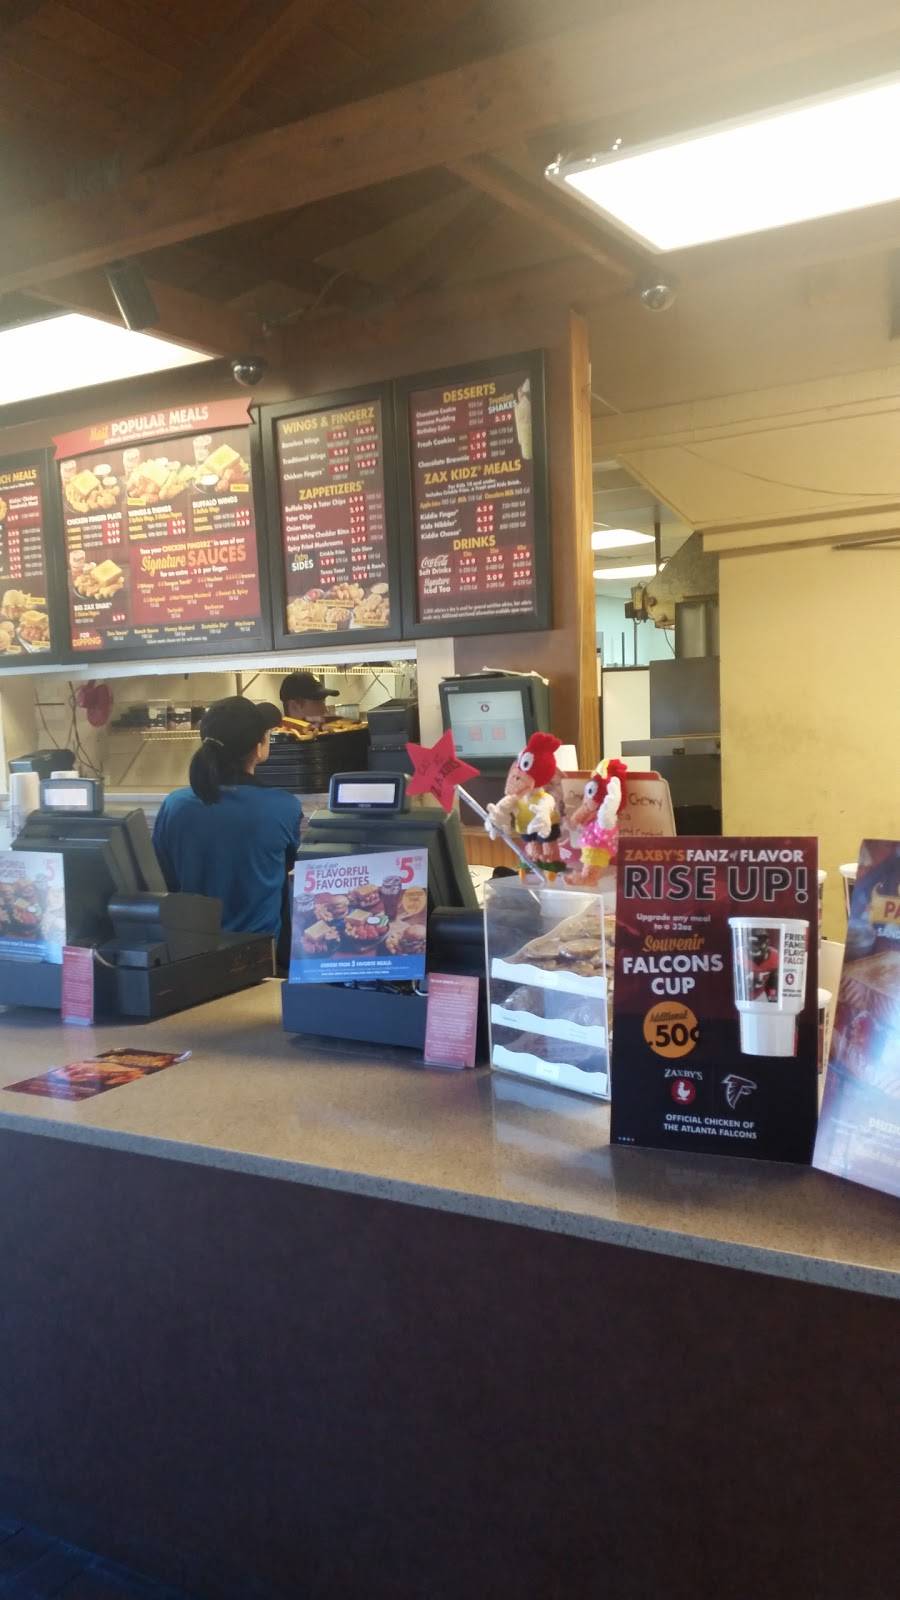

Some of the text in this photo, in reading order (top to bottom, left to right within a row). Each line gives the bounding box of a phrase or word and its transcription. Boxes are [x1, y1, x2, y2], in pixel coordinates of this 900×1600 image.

[443, 382, 496, 403] DESSERTS
[111, 413, 166, 437] POPULAR
[169, 406, 209, 425] MEALS
[282, 407, 375, 435] WINGS & FINGERZ
[424, 471, 448, 485] ZAX
[483, 459, 522, 475] MEALS
[298, 482, 362, 500] ZAPPETIZERS
[453, 535, 496, 551] DRINKS
[141, 544, 247, 577] Signature SAUCES
[291, 560, 314, 571] SIDES
[624, 849, 685, 862] ZAXBY'S
[686, 849, 729, 862] FANZ
[740, 849, 804, 863] FLAVOR
[303, 868, 317, 893] 5
[316, 865, 370, 879] FLAVORFUL
[316, 876, 370, 890] FAVORITES
[623, 865, 809, 904] RISE UP!
[636, 912, 711, 923] Upgrade any meal
[642, 934, 705, 952] Souvenir
[622, 955, 724, 975] FALCONS
[651, 976, 696, 996] CUP
[664, 1068, 703, 1081] ZAXBY'S
[666, 1113, 755, 1129] OFFICIAL CHICKEN OF
[663, 1122, 757, 1140] THE ATLANTA FALCONS
